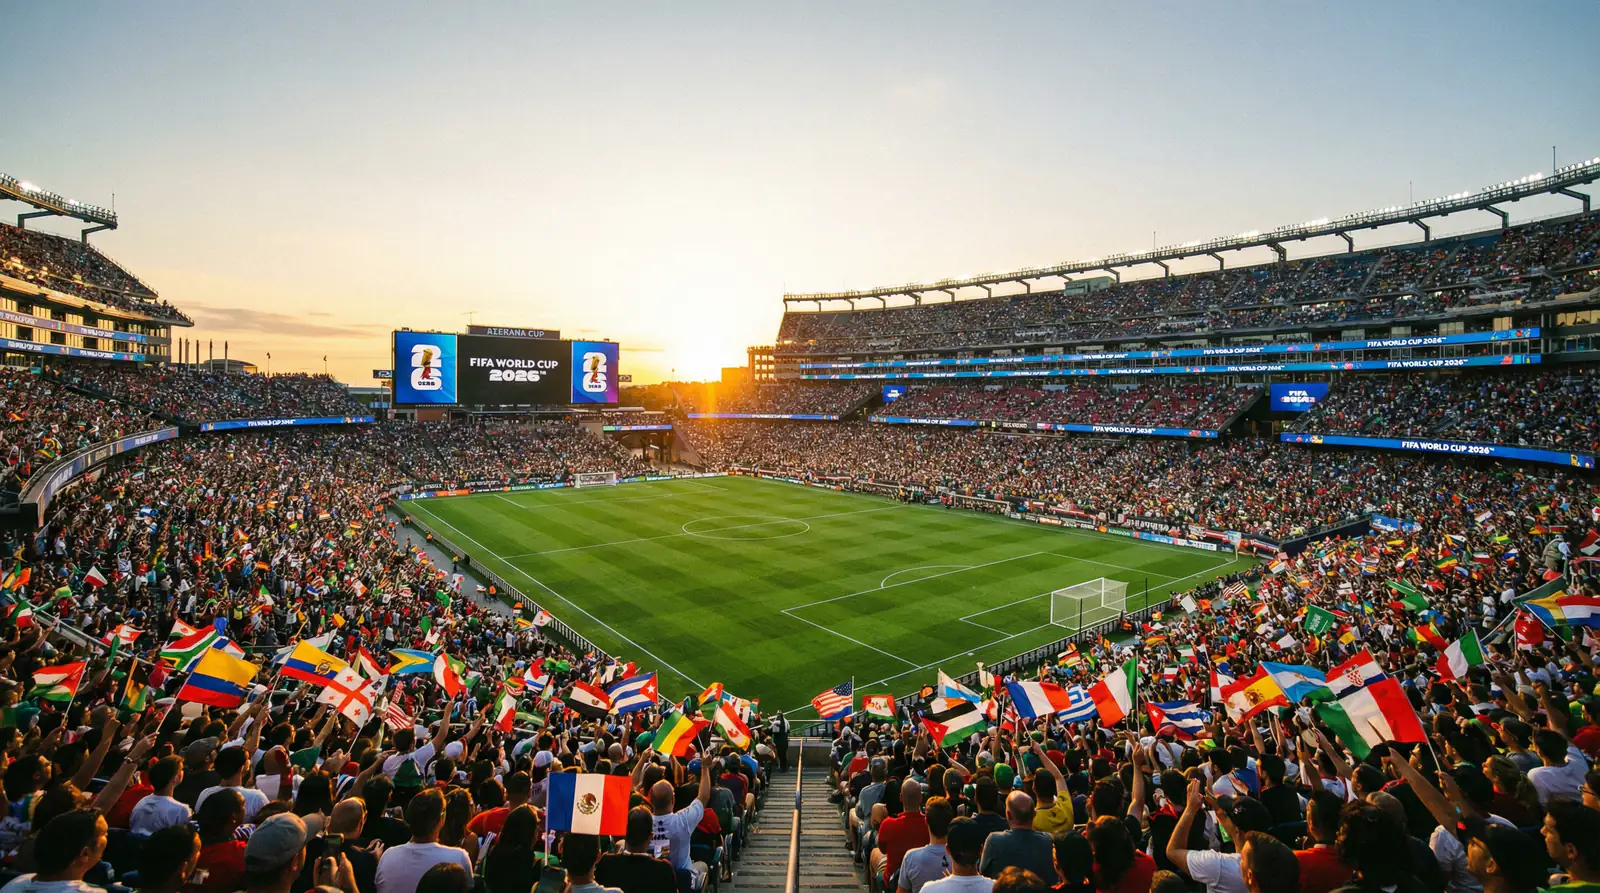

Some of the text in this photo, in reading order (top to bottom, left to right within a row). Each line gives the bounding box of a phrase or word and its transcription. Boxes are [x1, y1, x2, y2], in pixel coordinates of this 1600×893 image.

[528, 330, 545, 338] CUP
[470, 358, 558, 369] FIFA WORLD CUP
[1402, 441, 1419, 449] FIFA
[1420, 442, 1449, 451] WORLD
